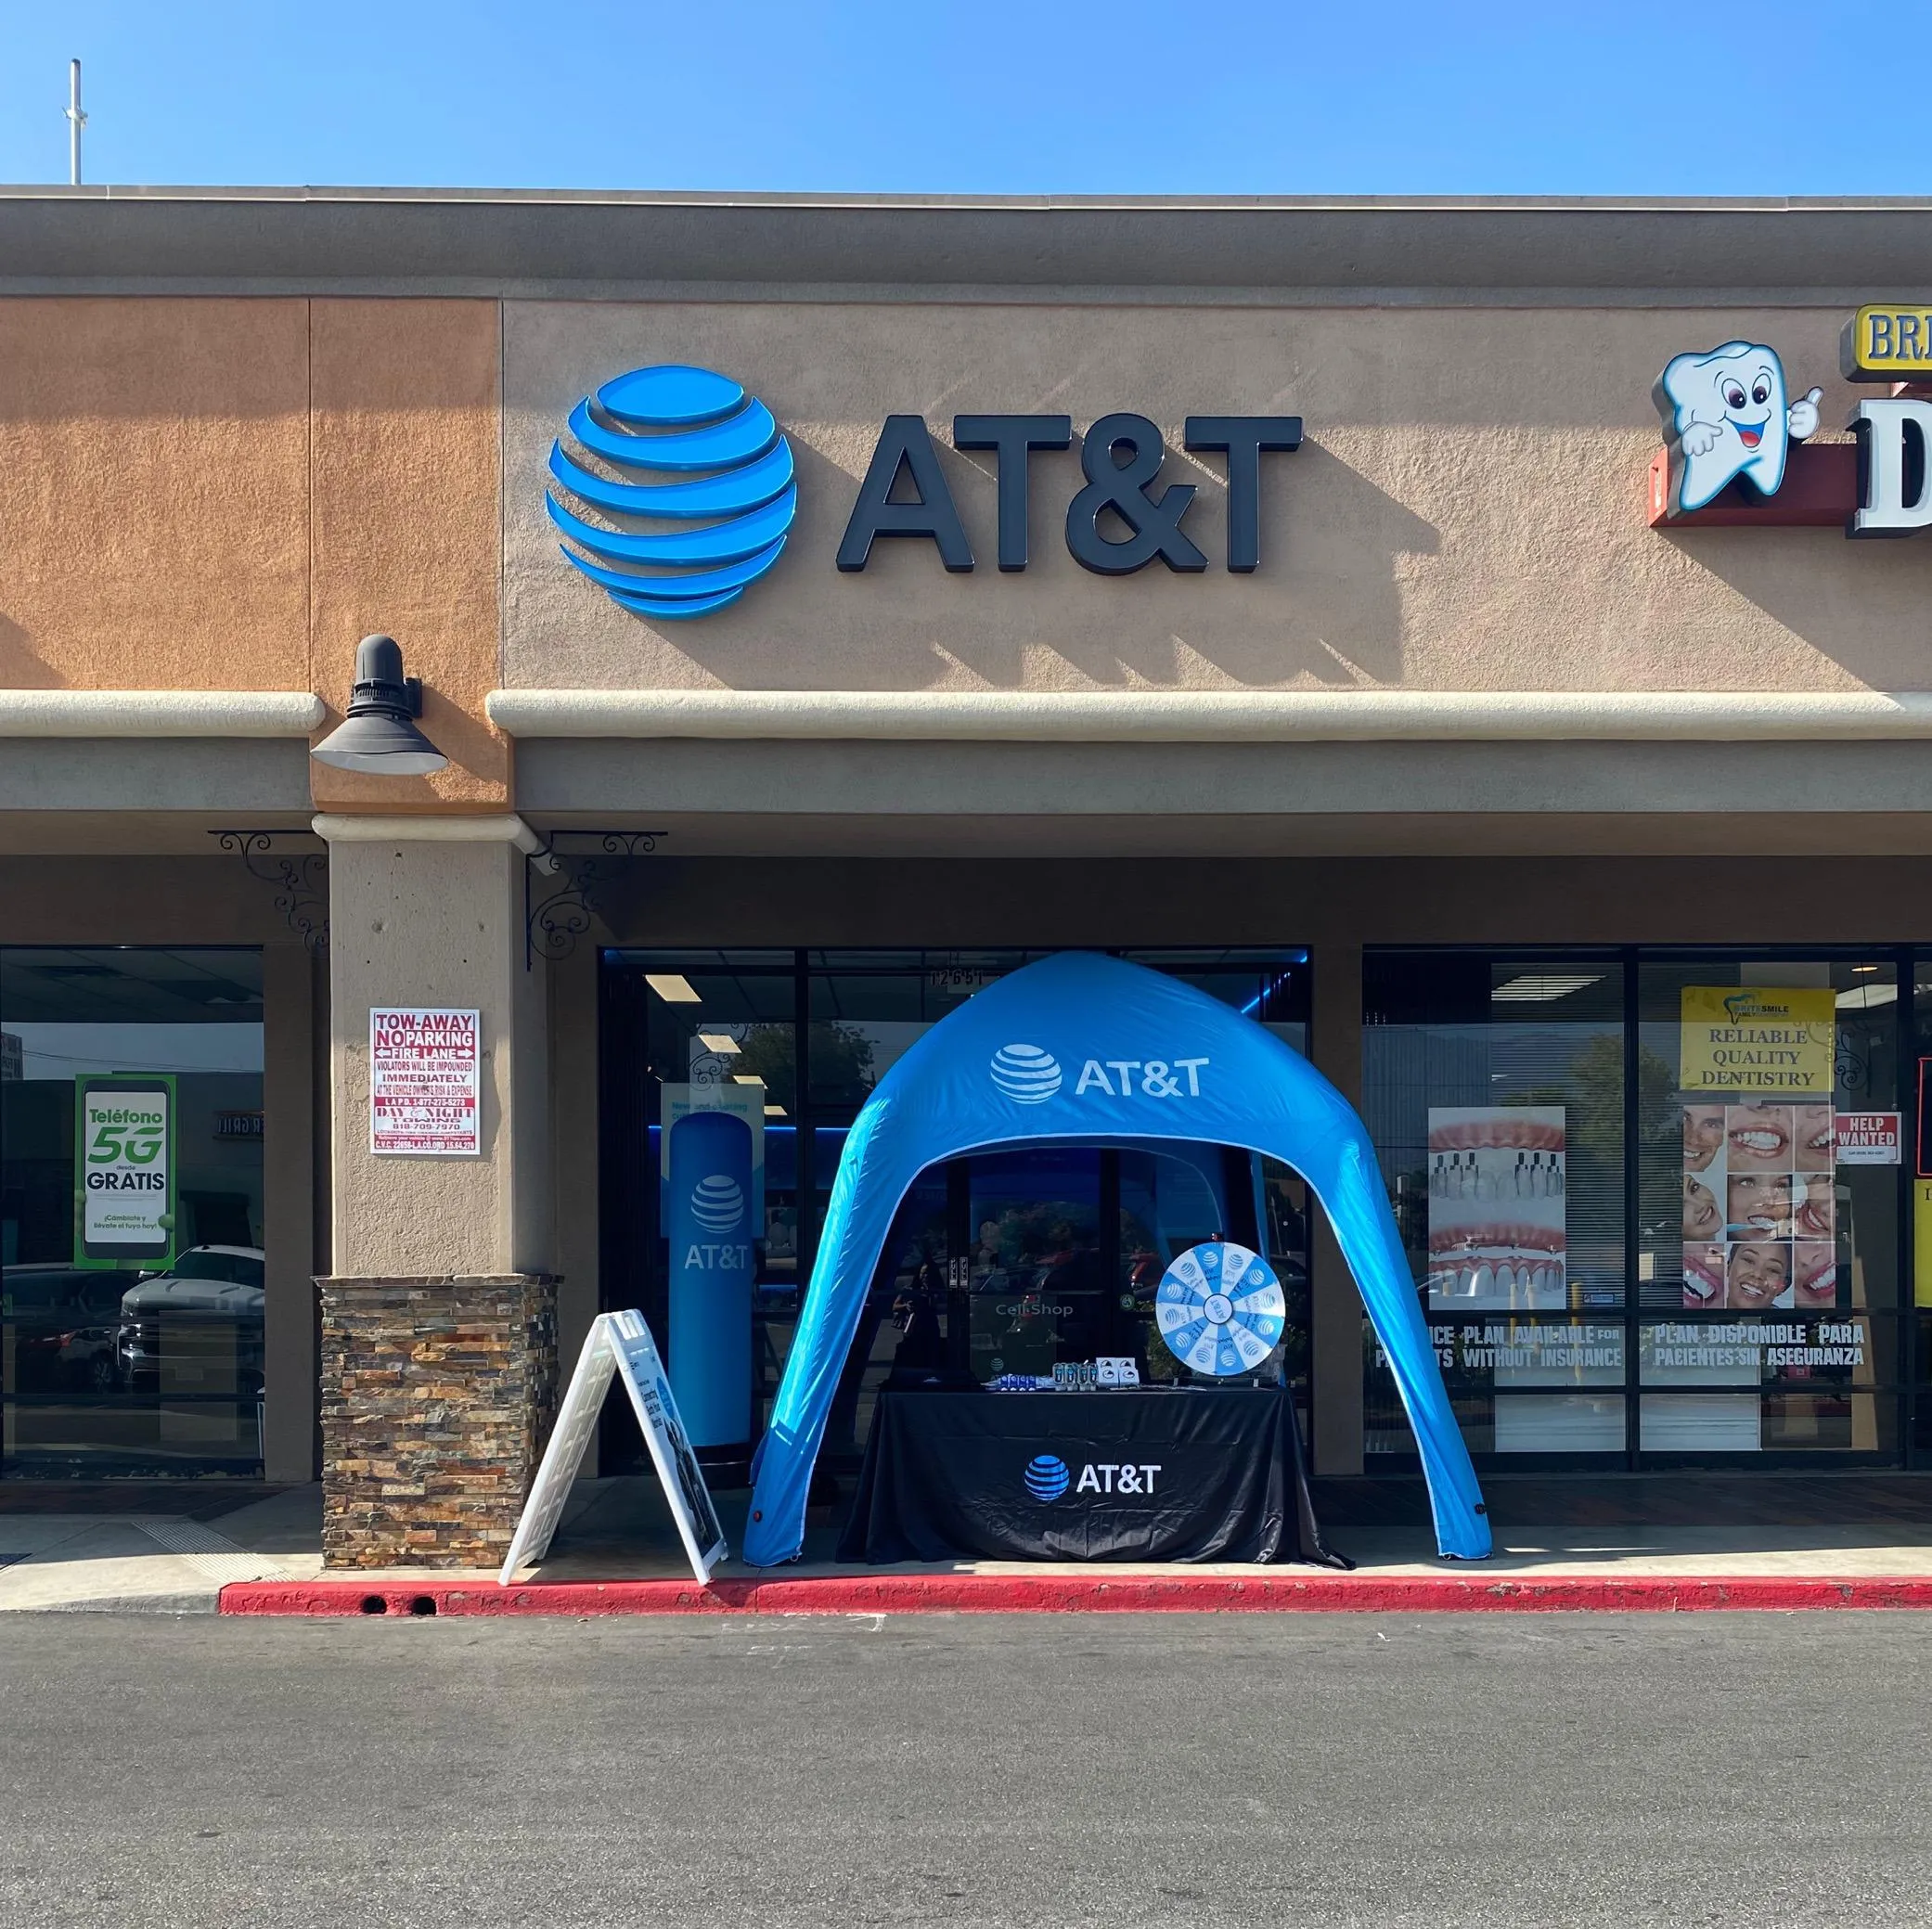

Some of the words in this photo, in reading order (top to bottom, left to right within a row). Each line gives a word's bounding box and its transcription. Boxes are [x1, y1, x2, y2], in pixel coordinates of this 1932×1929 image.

[835, 413, 1303, 576] AT&T
[376, 1014, 472, 1030] TOW-AWAY
[376, 1030, 405, 1047] NO
[406, 1031, 473, 1047] PARKING
[1709, 1029, 1808, 1045] RELIABLE
[392, 1048, 420, 1059] FIRE
[423, 1048, 457, 1059] LANE
[1713, 1050, 1801, 1067] QUALITY
[377, 1061, 410, 1071] VIOLATORS
[412, 1061, 427, 1071] WILL
[427, 1062, 435, 1071] BE
[436, 1061, 473, 1072] IMPOUNDED
[382, 1074, 468, 1083] IMMEDIATELY
[1075, 1058, 1209, 1098] AT&T
[1702, 1071, 1815, 1086] DENTISTRY
[89, 1109, 163, 1124] Teléfono
[377, 1107, 404, 1117] DAY
[425, 1107, 474, 1118] NIGHT
[1849, 1117, 1885, 1131] HELP
[87, 1126, 163, 1164] 5G
[1838, 1132, 1895, 1146] WANTED
[86, 1172, 165, 1190] GRATIS
[684, 1244, 749, 1270] AT&T
[996, 1304, 1025, 1316] Cell
[1031, 1304, 1074, 1318] Shop
[1463, 1326, 1504, 1344] PLAN
[1513, 1326, 1594, 1344] AVAILABLE
[1598, 1329, 1619, 1340] FOR
[1655, 1325, 1699, 1344] PLAN
[1707, 1325, 1807, 1344] DISPONIBLE
[1819, 1325, 1865, 1344] PARA
[1462, 1348, 1534, 1368] WITHOUT
[1540, 1348, 1622, 1368] INSURANCE
[1655, 1347, 1734, 1367] PACIENTES
[1738, 1347, 1761, 1367] SIN
[1767, 1347, 1864, 1367] ASEGURANZA
[1076, 1464, 1162, 1494] AT&T
